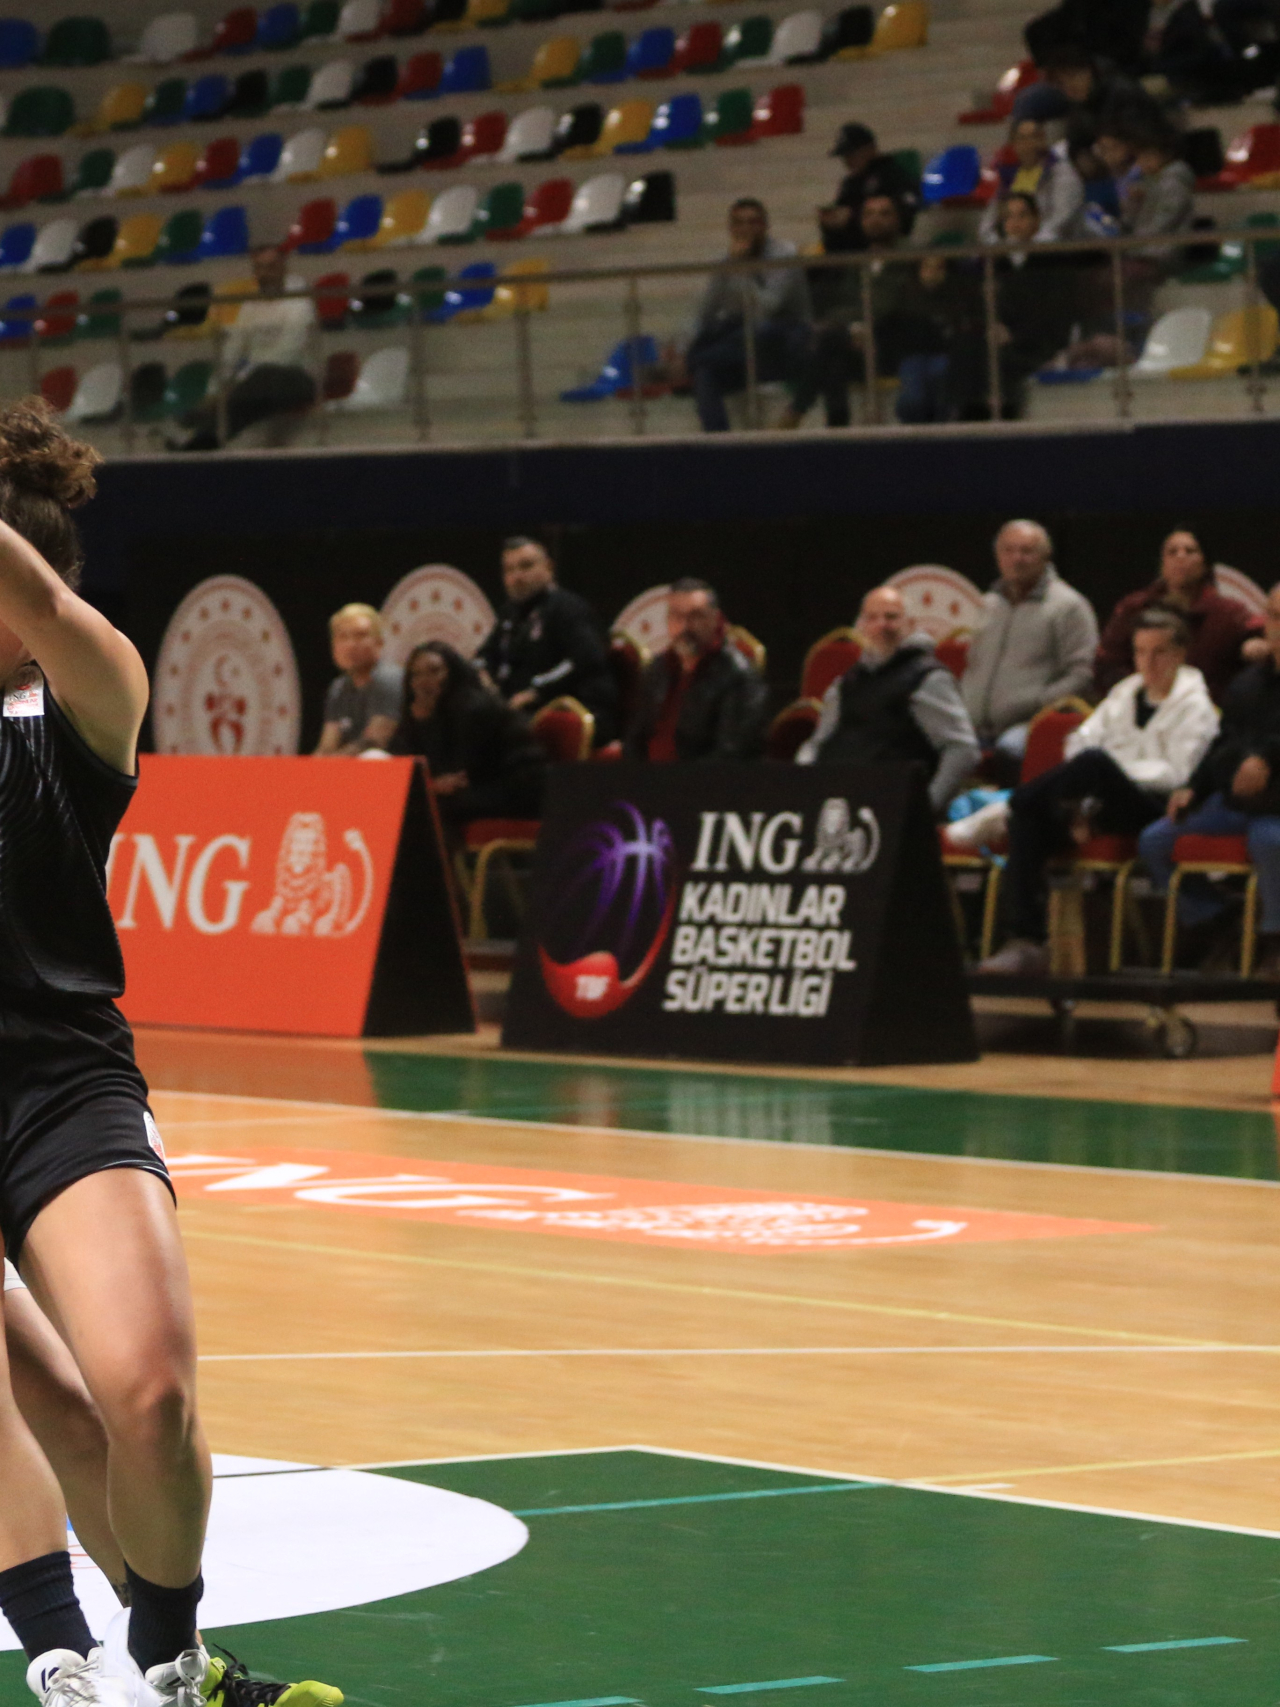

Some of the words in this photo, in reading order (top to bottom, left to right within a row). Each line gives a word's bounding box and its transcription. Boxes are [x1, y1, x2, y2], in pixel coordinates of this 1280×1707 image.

[691, 811, 804, 874] ING
[679, 881, 846, 927] KADINLAR
[671, 925, 857, 971] BASKETBOL
[662, 965, 770, 1014] SÜPER
